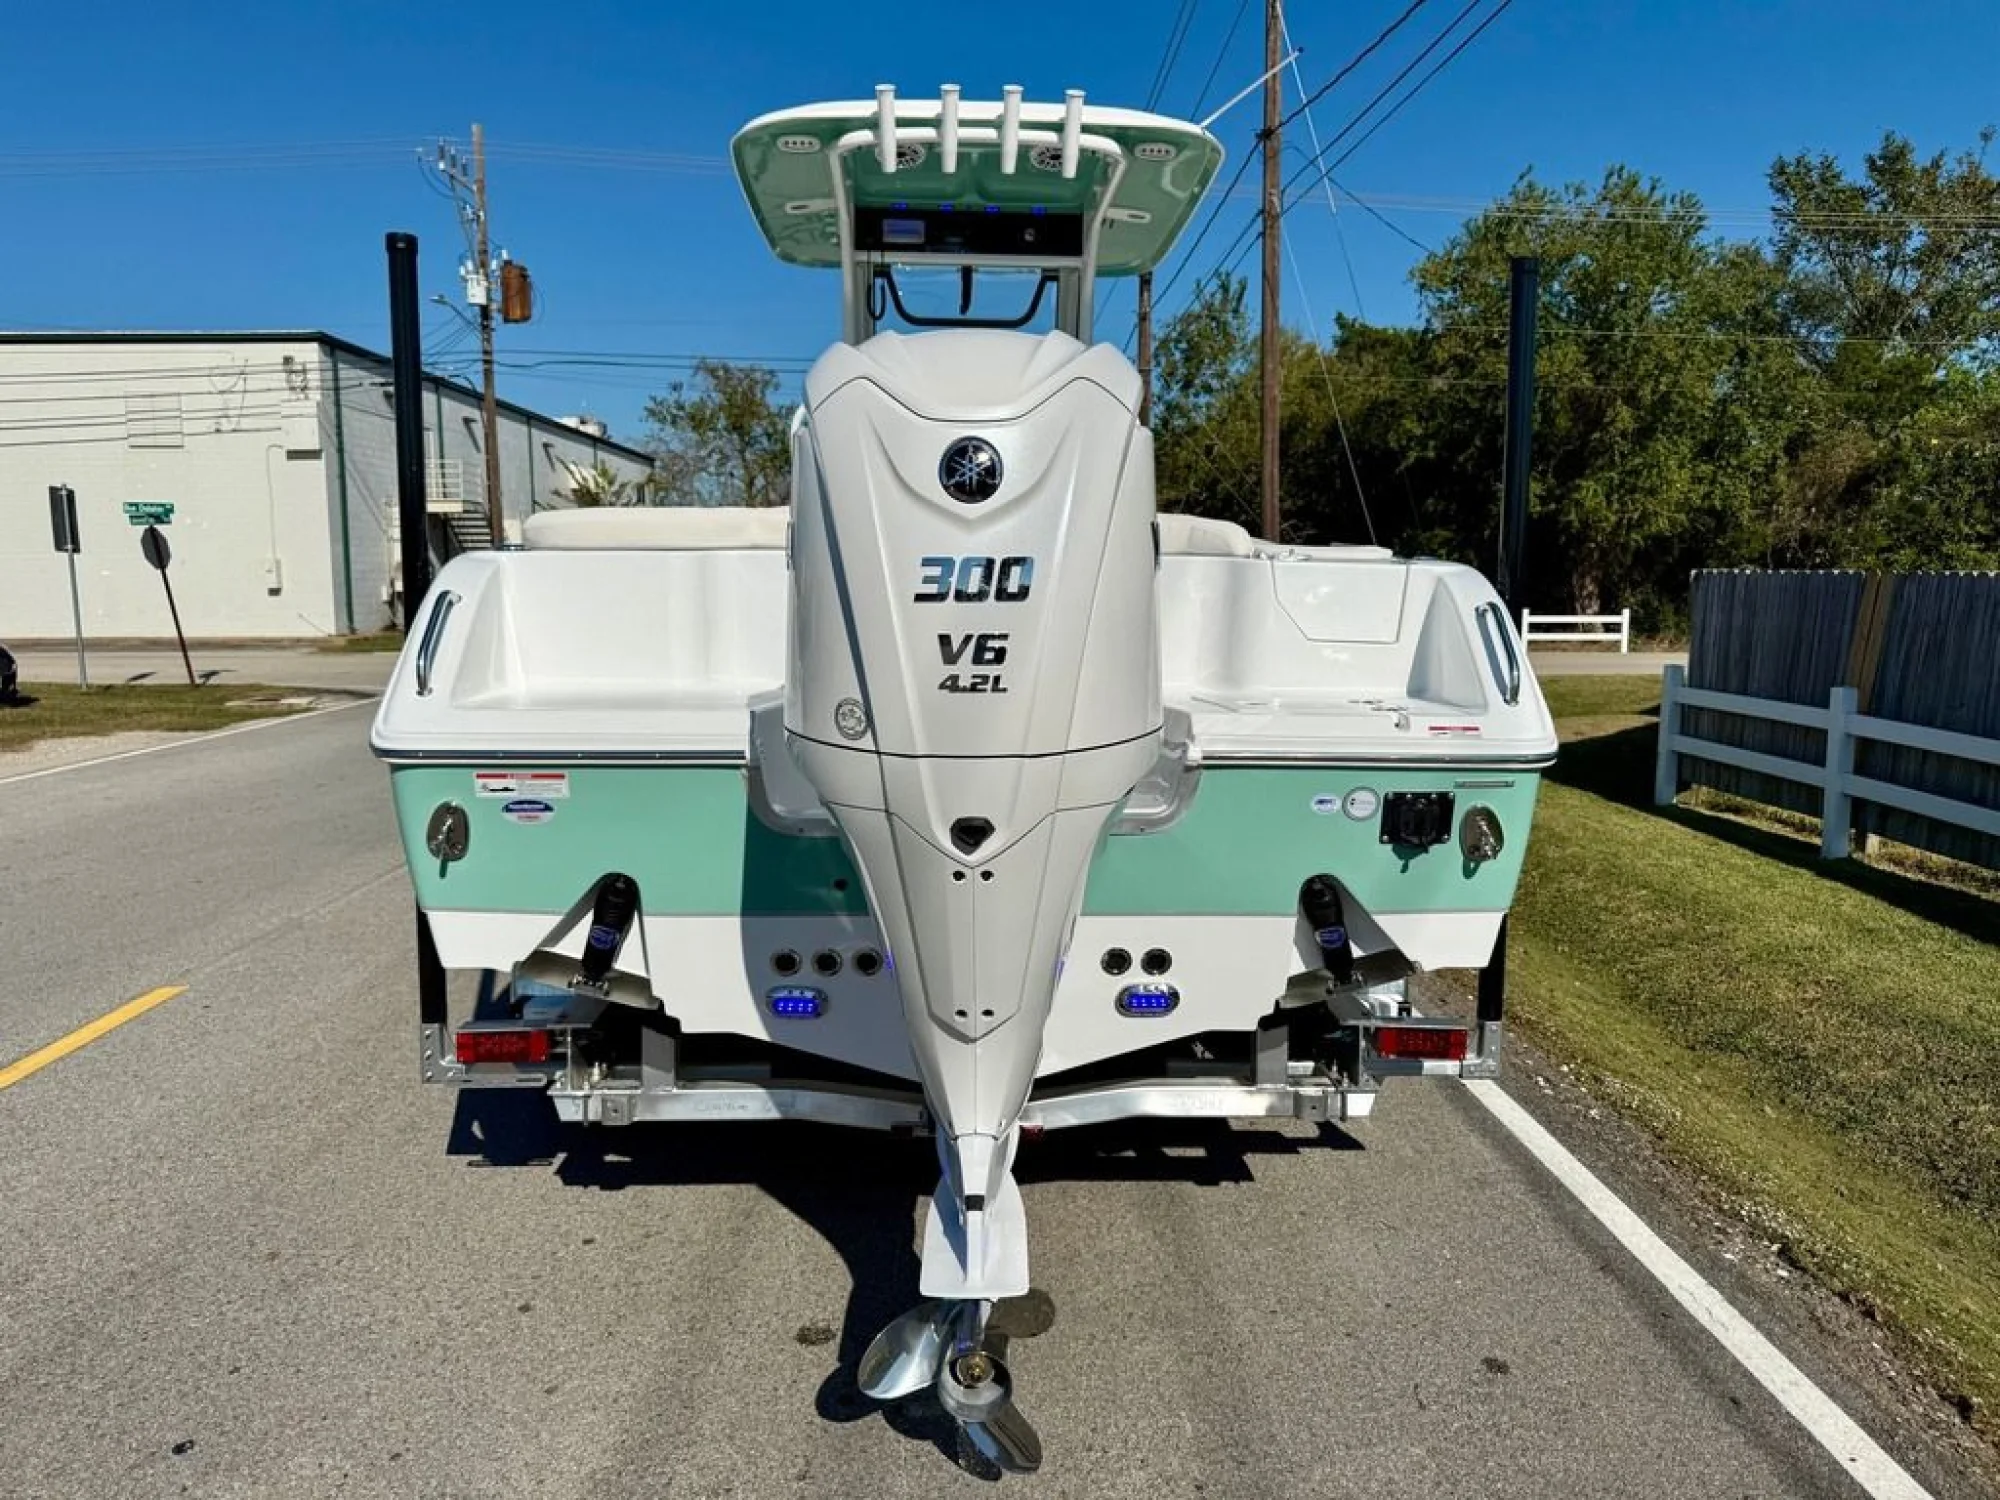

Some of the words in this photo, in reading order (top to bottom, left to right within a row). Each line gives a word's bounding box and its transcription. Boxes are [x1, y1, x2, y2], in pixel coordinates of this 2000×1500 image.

[914, 556, 1034, 603] 300
[937, 633, 1010, 666] V6
[937, 673, 1009, 693] 4.2L
